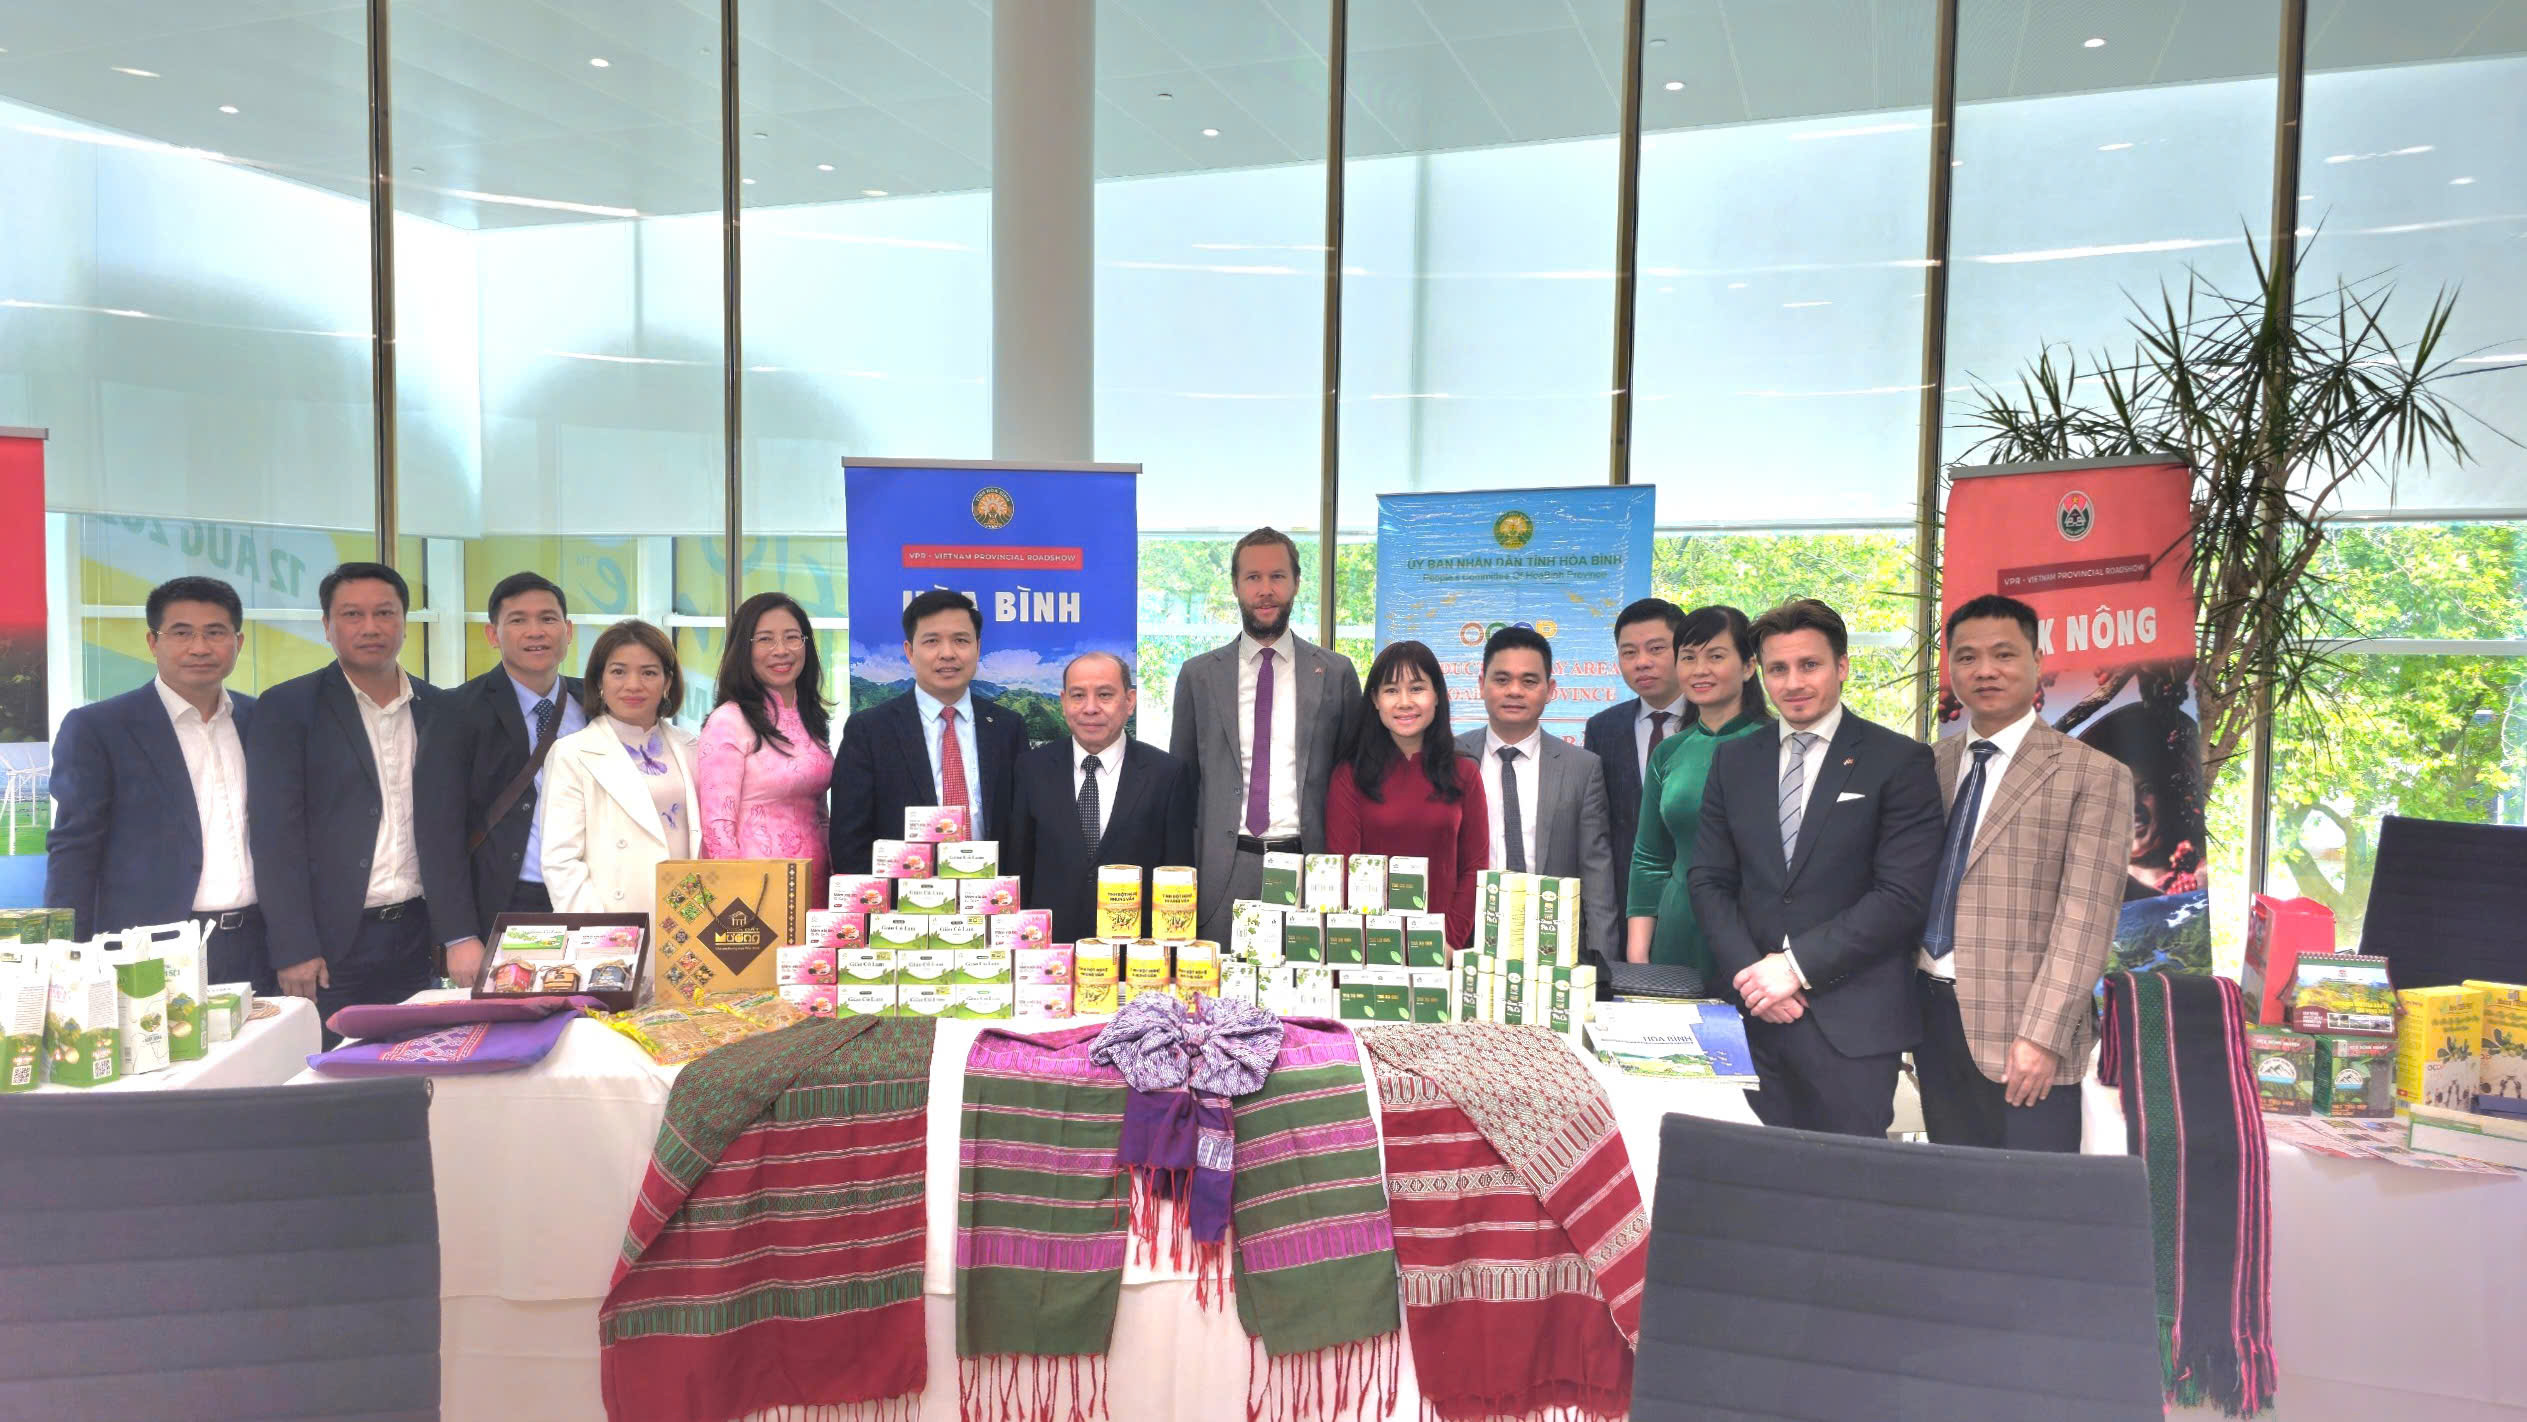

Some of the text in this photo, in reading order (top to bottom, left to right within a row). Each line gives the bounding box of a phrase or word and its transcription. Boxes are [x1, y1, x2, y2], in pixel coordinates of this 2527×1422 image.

[909, 552, 926, 560] VPR
[934, 552, 972, 560] VIETNAM
[974, 553, 1024, 561] PROVINCIAL
[1027, 554, 1076, 562] ROADSHOW
[1428, 559, 1453, 569] BAN
[2004, 577, 2021, 586] VPR
[2027, 574, 2056, 584] VIETNAM
[2057, 569, 2104, 580] PROVINCIAL
[2105, 564, 2145, 575] ROADSHOW
[994, 585, 1081, 623] BÌNH
[2066, 604, 2157, 652] NÔNG
